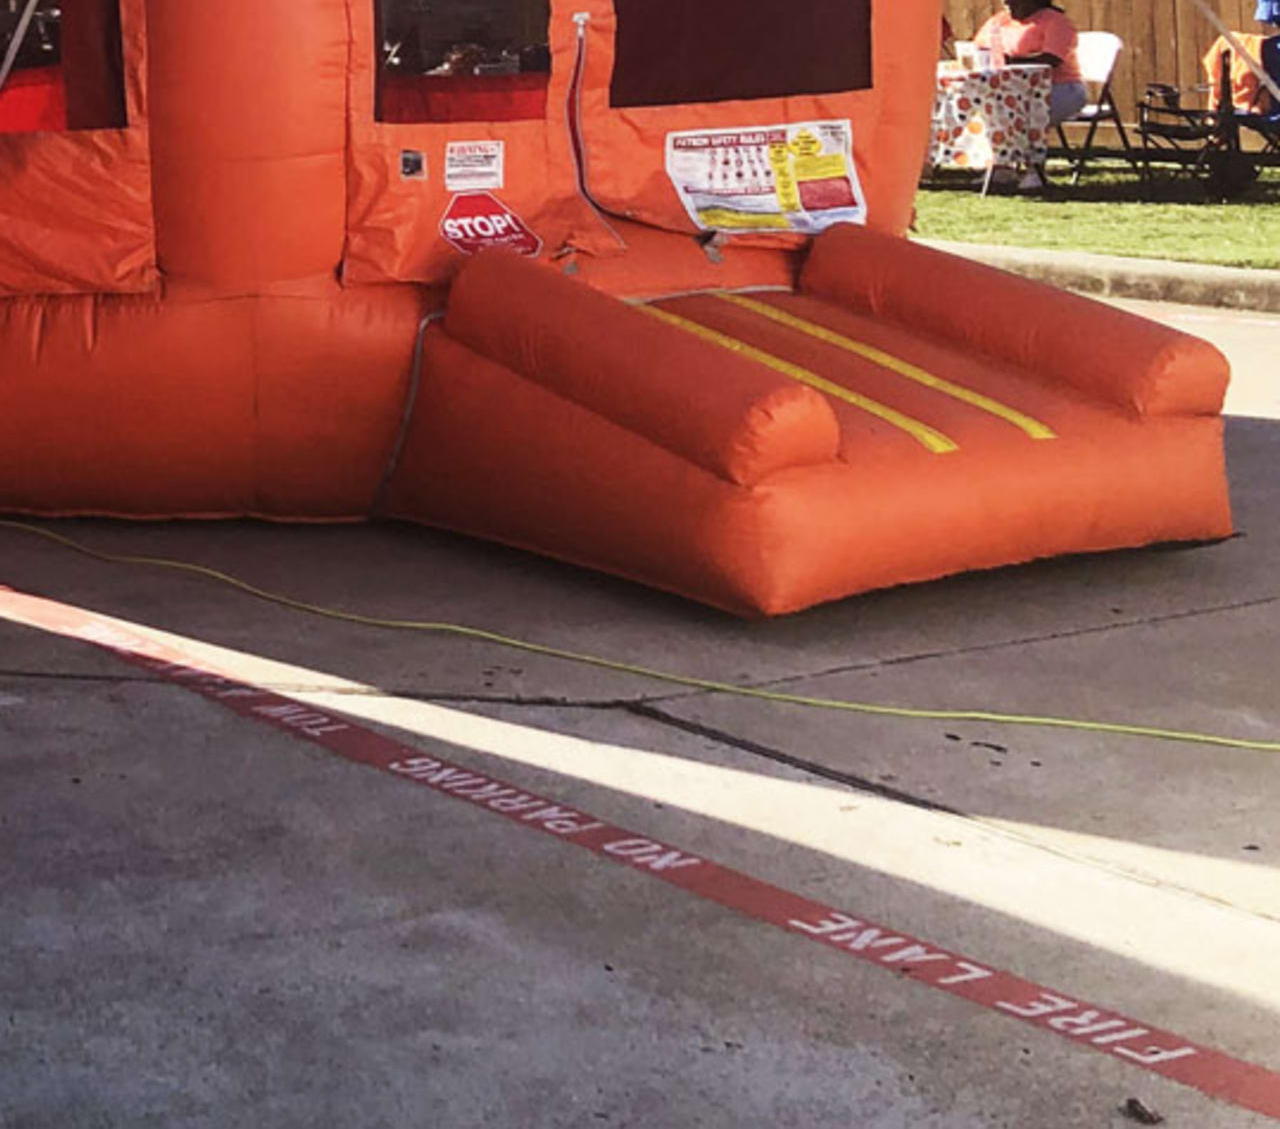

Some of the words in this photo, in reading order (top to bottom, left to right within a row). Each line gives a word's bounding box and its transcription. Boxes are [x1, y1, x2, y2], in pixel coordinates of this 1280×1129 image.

[444, 213, 520, 239] STOP!
[389, 756, 604, 834] PARKING
[603, 838, 701, 870] NO
[789, 912, 994, 984] LANE
[994, 992, 1197, 1064] FIRE
